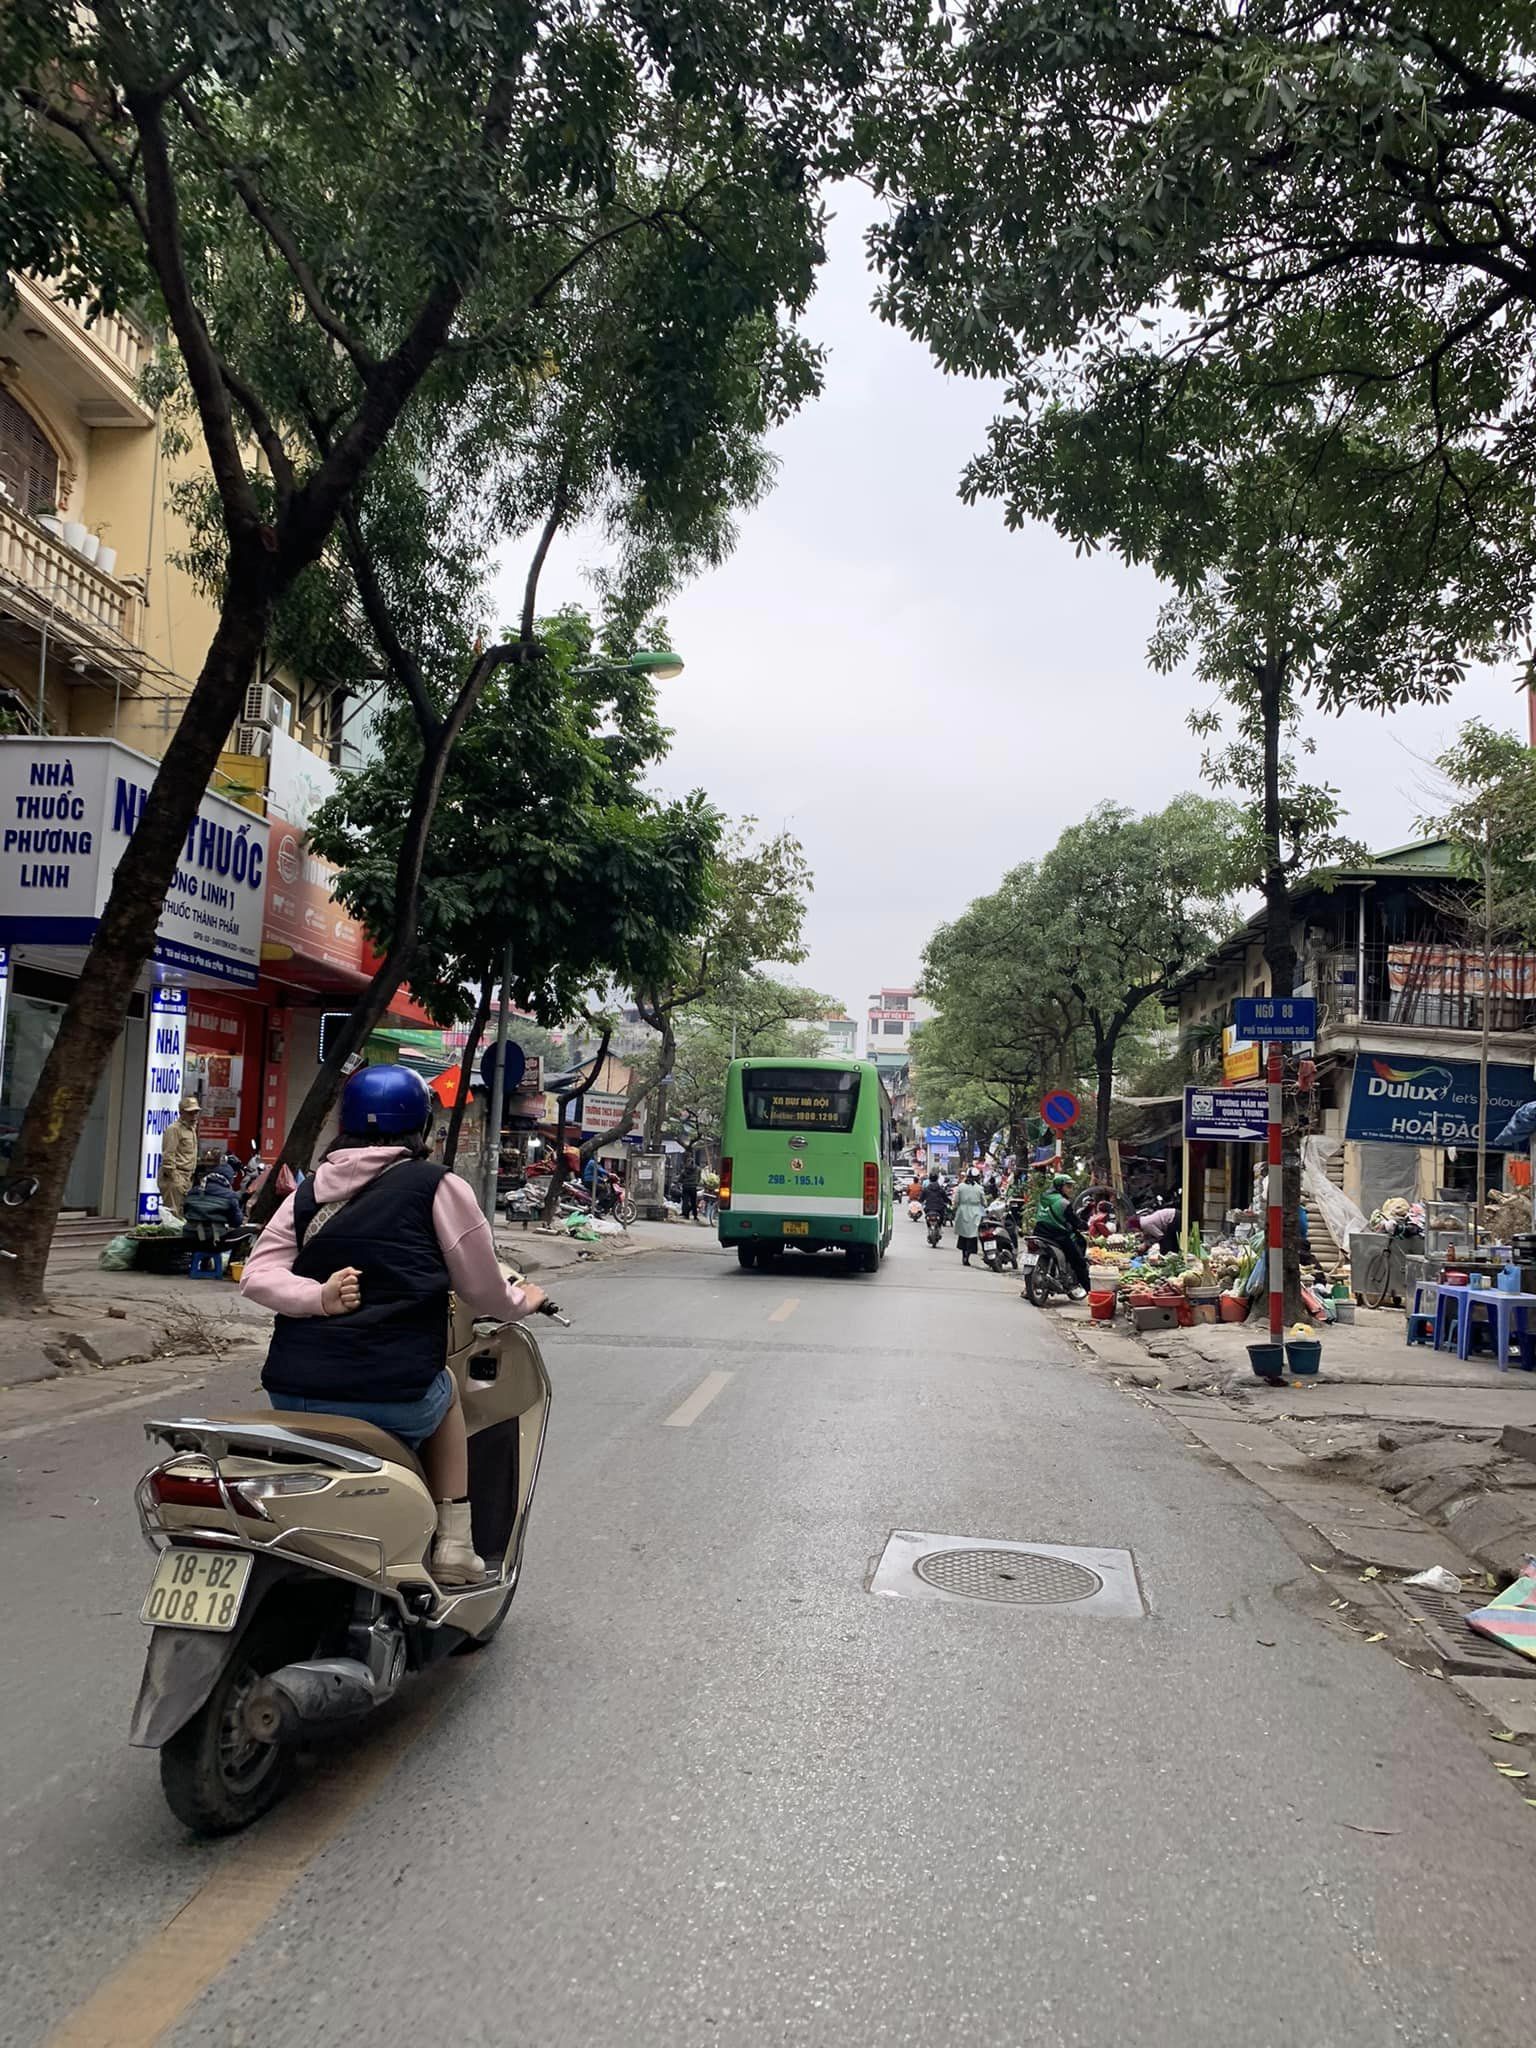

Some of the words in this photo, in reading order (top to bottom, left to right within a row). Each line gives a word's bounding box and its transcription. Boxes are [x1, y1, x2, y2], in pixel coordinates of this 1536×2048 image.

[30, 759, 74, 786] NHÀ
[16, 790, 84, 820] THUỐC
[4, 828, 92, 855] PHƯƠNG
[20, 864, 70, 888] LINH
[201, 880, 227, 907] LINH
[229, 892, 235, 910] 1
[160, 988, 182, 1002] 85
[1255, 1001, 1275, 1018] NGÕ
[1281, 1004, 1294, 1018] 88
[156, 1026, 180, 1055] NHÀ
[151, 1064, 181, 1094] THUỐC
[1368, 1078, 1438, 1101] Dulux
[1452, 1094, 1478, 1105] let's
[1486, 1096, 1524, 1108] olour
[1391, 1118, 1434, 1137] HOA
[795, 1175, 825, 1187] 195.14
[171, 1553, 238, 1589] 18-B2
[149, 1587, 235, 1625] 008.18
